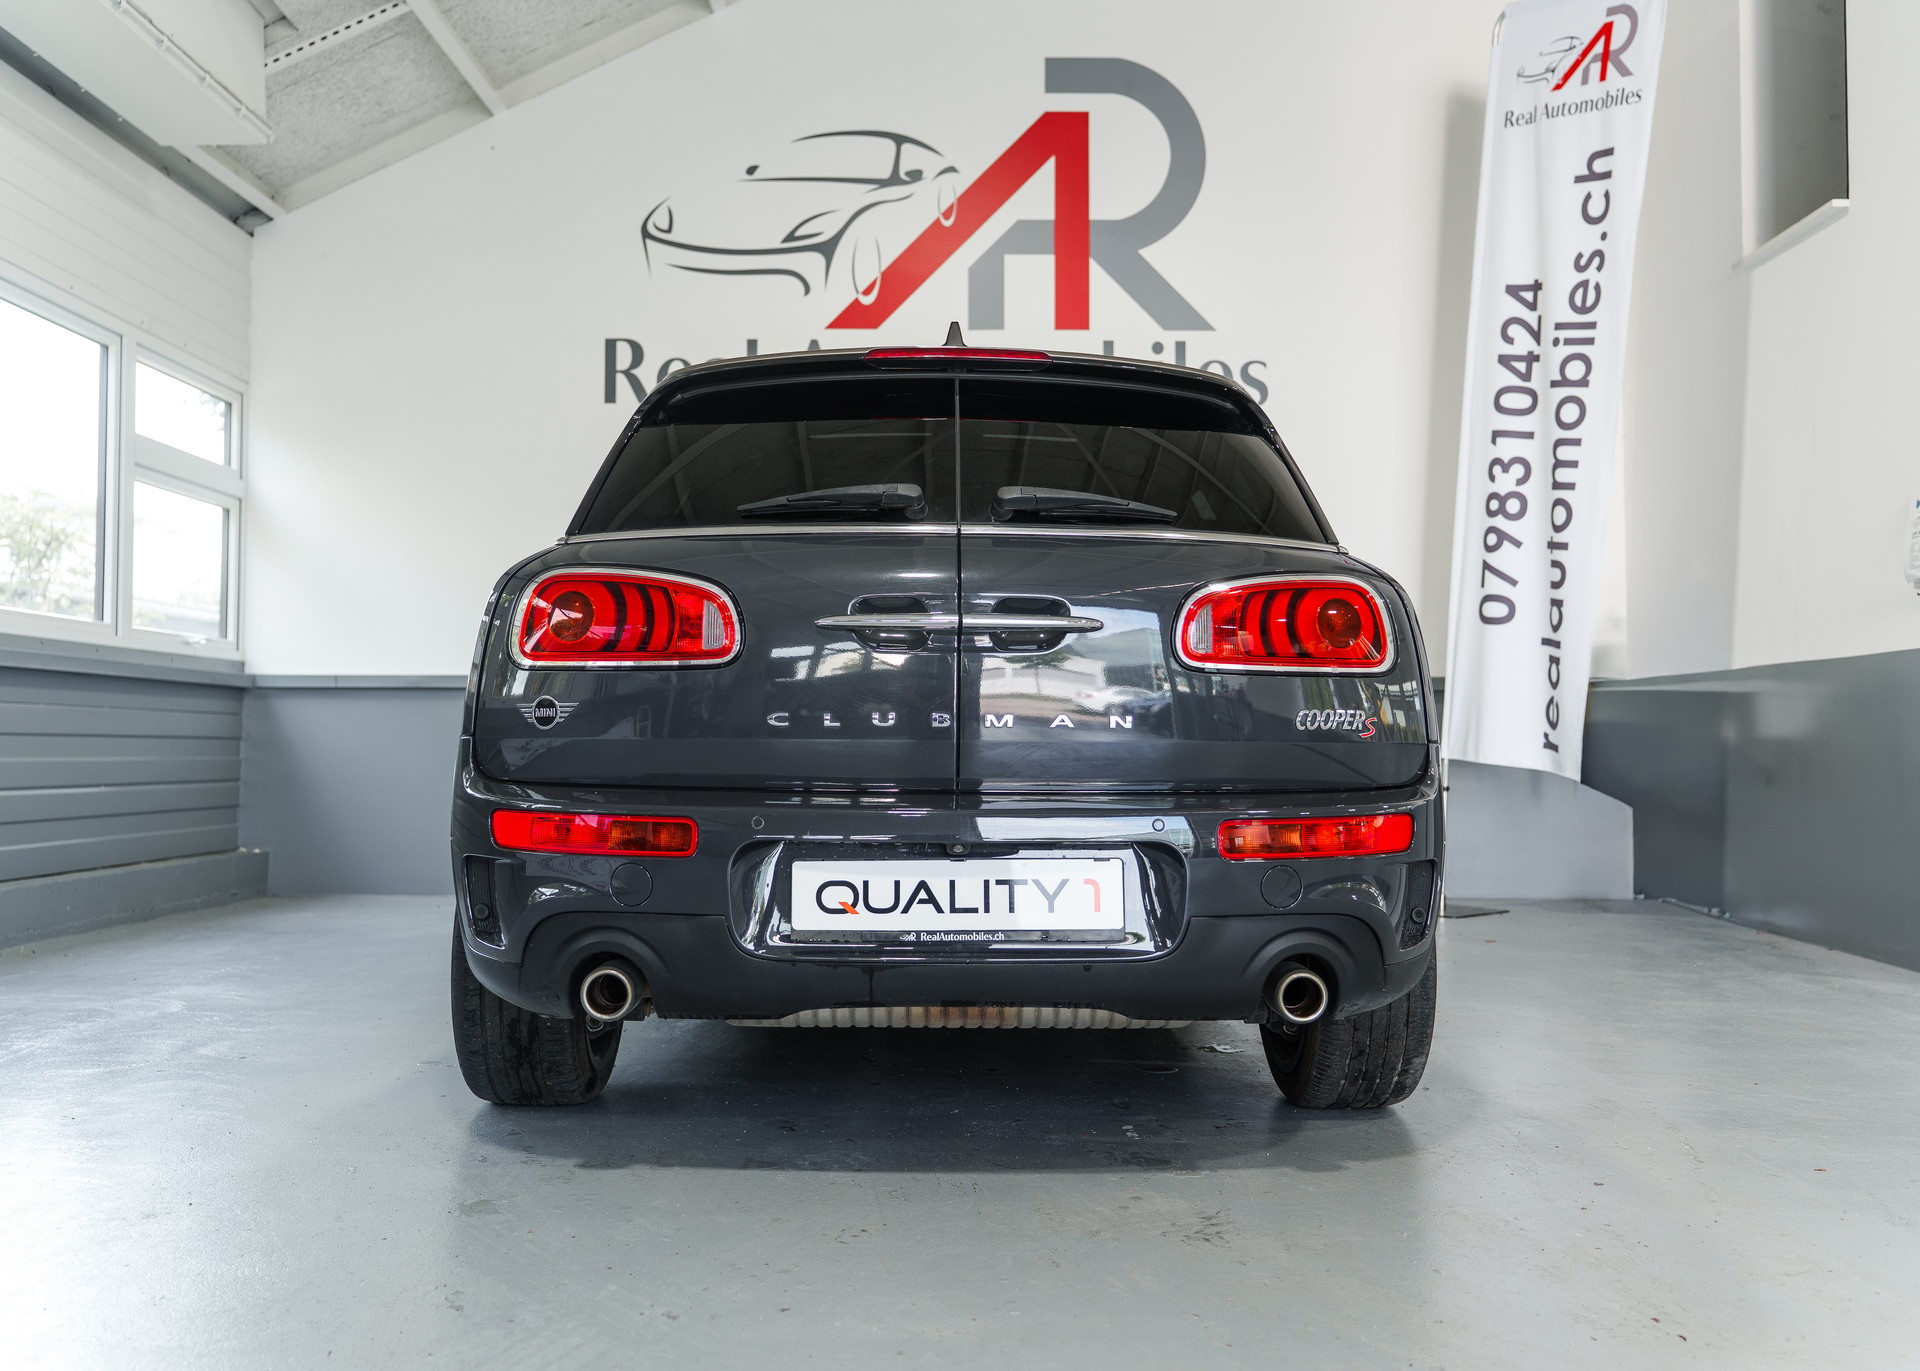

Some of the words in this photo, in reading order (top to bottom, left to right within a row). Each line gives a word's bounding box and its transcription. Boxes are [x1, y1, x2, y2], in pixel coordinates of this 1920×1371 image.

[1504, 105, 1537, 128] Real
[1541, 88, 1643, 120] Automobiles
[1479, 279, 1543, 626] 0798310424
[1541, 146, 1615, 753] realautomobiles.ch
[535, 707, 556, 717] MINI
[766, 712, 1133, 729] CLUBMAN
[920, 931, 1005, 941] RealAutomobiles.ch
